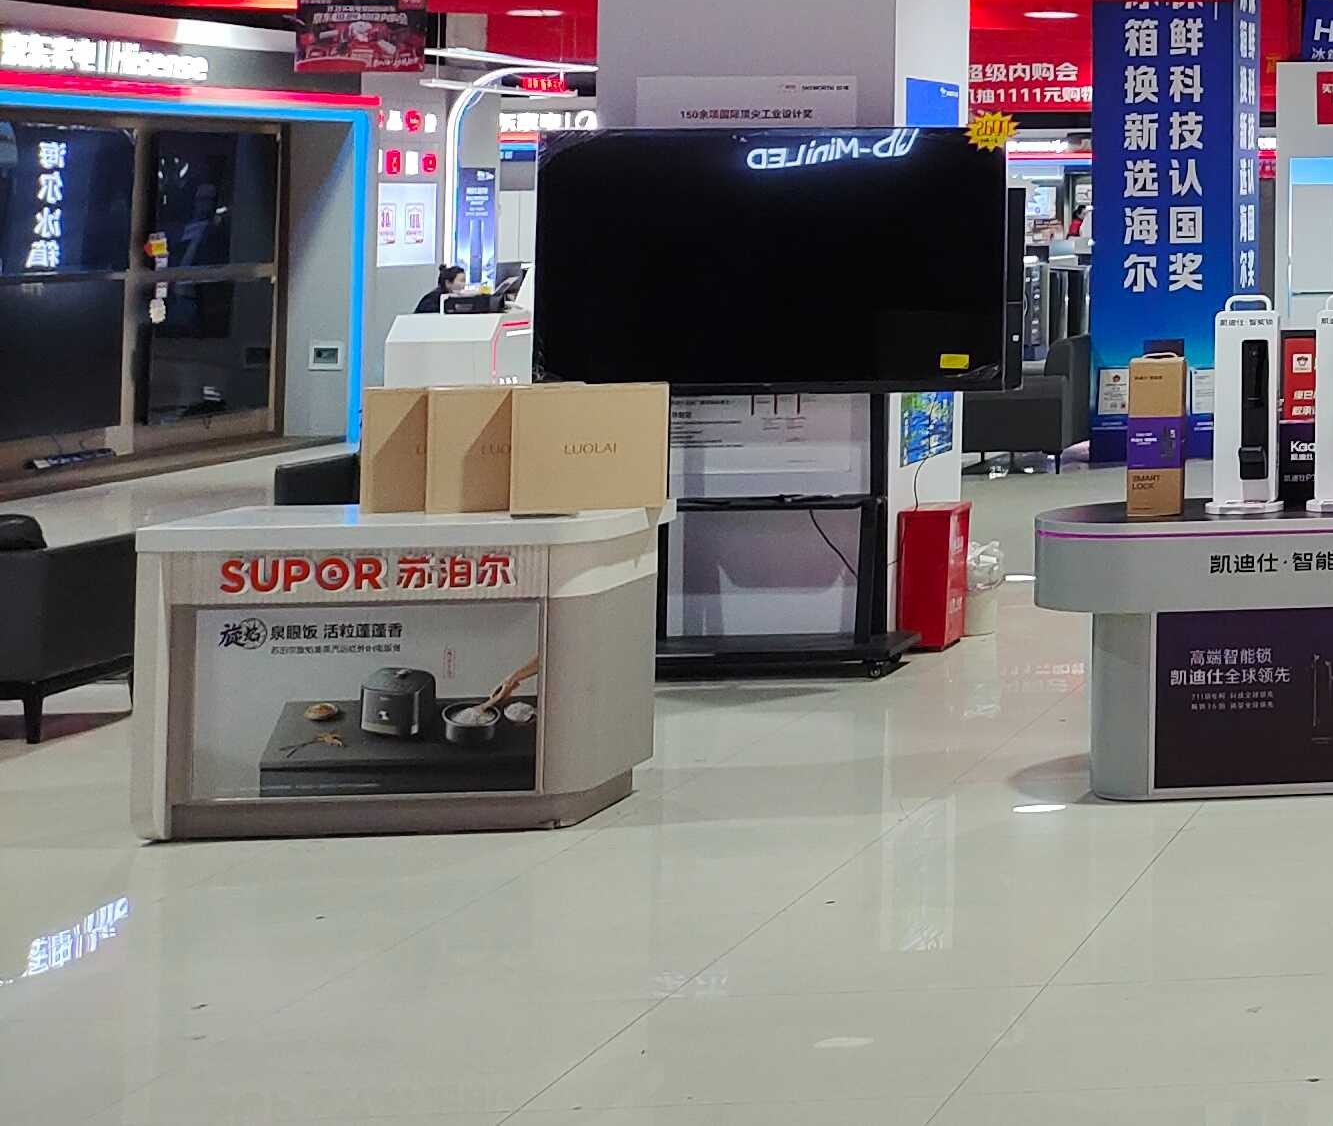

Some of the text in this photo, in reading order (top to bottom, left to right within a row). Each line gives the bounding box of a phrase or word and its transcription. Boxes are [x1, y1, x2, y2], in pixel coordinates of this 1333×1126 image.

[563, 441, 618, 456] LUOLAI
[219, 552, 514, 595] SUPOR 苏泊尔
[1189, 647, 1273, 666] 高端智能锁
[1170, 666, 1291, 686] 凯迪仕全球领先
